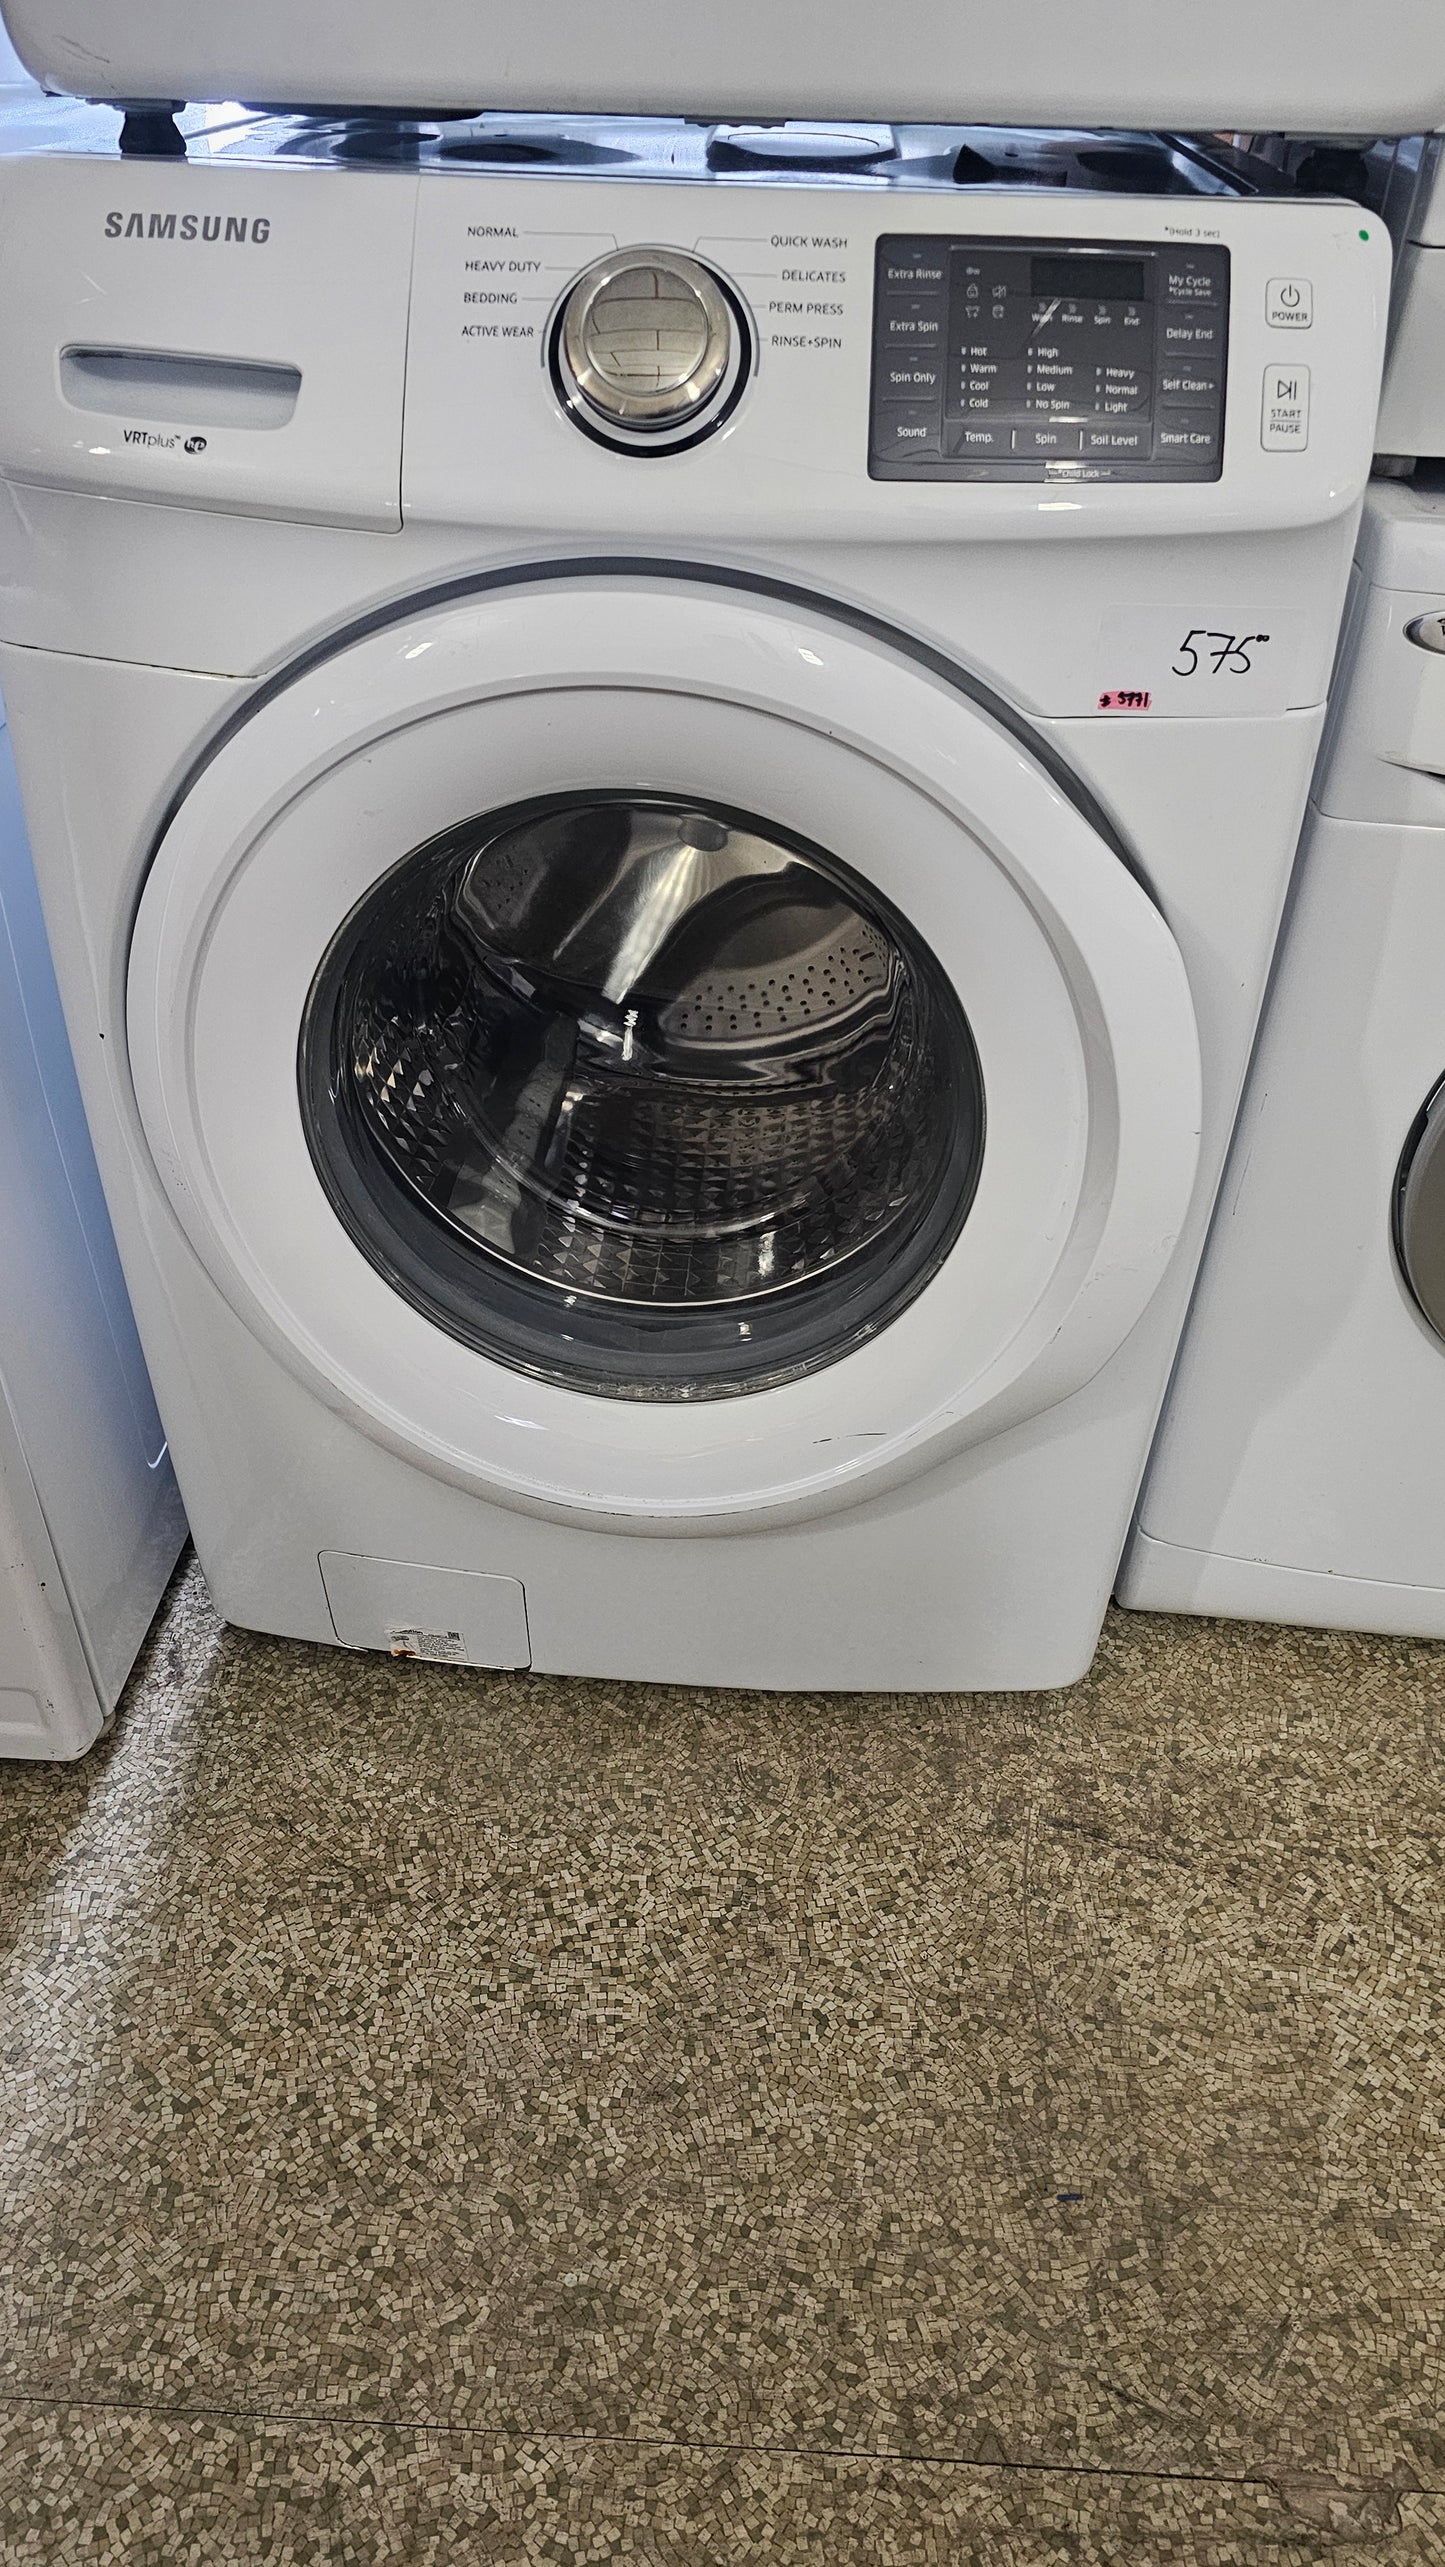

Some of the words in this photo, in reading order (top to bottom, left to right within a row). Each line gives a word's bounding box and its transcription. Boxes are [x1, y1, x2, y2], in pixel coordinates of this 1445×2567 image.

[104, 211, 271, 244] SAMSUNG
[466, 226, 519, 238] NORMAL
[770, 234, 808, 248] QUICK
[811, 237, 848, 249] WASH
[464, 260, 506, 272] HEAVY
[508, 261, 541, 273] DUTY
[781, 270, 847, 283] DELICATES
[887, 268, 914, 279] Extra
[915, 268, 943, 280] Rinse
[1168, 275, 1184, 287] My
[1186, 276, 1212, 287] Cycle
[463, 292, 518, 304] BEDDING
[1194, 288, 1212, 297] Save
[768, 301, 803, 313] PERM
[806, 303, 844, 315] PRESS
[1061, 314, 1084, 324] Rinse
[1093, 315, 1112, 325] Spin
[1123, 316, 1141, 326] End
[1272, 312, 1308, 322] POWER
[461, 325, 499, 338] ACTIVE
[501, 326, 534, 338] WEAR
[889, 320, 915, 332] Extra
[917, 320, 939, 333] Spin
[1166, 327, 1193, 341] Delay
[1195, 329, 1214, 340] End
[771, 335, 843, 349] RINSE+SPIN
[970, 346, 988, 357] Hot
[1037, 347, 1059, 359] High
[970, 364, 997, 374] Warm
[1036, 364, 1073, 376] Medium
[1106, 367, 1135, 380] Heavy
[890, 371, 911, 384] Spin
[913, 371, 936, 385] Only
[969, 381, 989, 391] Cool
[1036, 382, 1056, 393] Low
[1105, 384, 1138, 396] Normal
[1162, 379, 1180, 391] Self
[969, 398, 989, 409] Cold
[1035, 400, 1049, 410] No
[1050, 400, 1070, 412] Spin
[1105, 402, 1129, 414] Light
[1270, 408, 1302, 419] START
[897, 426, 928, 438] Sound
[1269, 423, 1302, 434] PAUSE
[964, 431, 995, 444] Temp.
[1035, 432, 1057, 445] Spin
[1090, 434, 1109, 446] Soil
[1111, 434, 1138, 446] Level
[1160, 431, 1188, 444] Smart
[1189, 432, 1212, 445] Care
[1082, 470, 1100, 479] Lock
